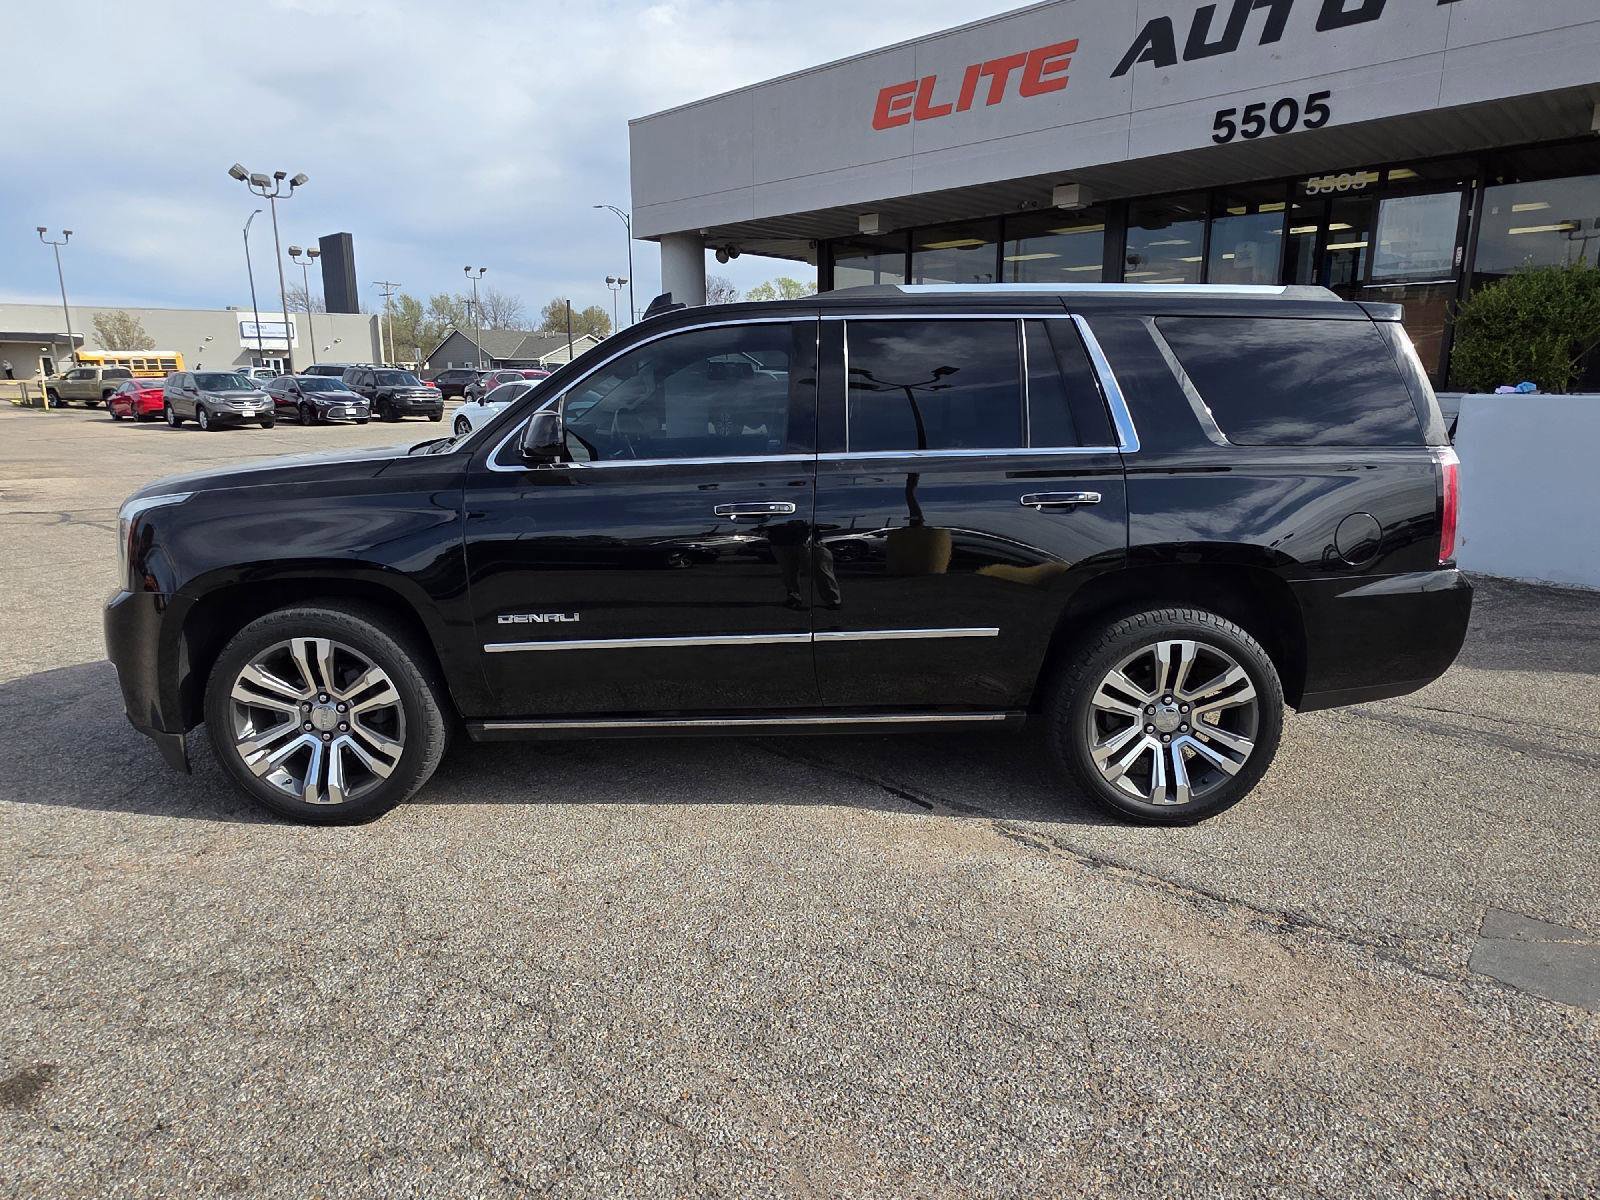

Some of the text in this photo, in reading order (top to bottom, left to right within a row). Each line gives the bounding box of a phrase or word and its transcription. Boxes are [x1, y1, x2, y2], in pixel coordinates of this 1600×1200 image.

[872, 38, 1079, 131] ELITE
[1212, 90, 1331, 144] 5505
[1305, 171, 1368, 195] 5505
[497, 612, 580, 624] DENALI
